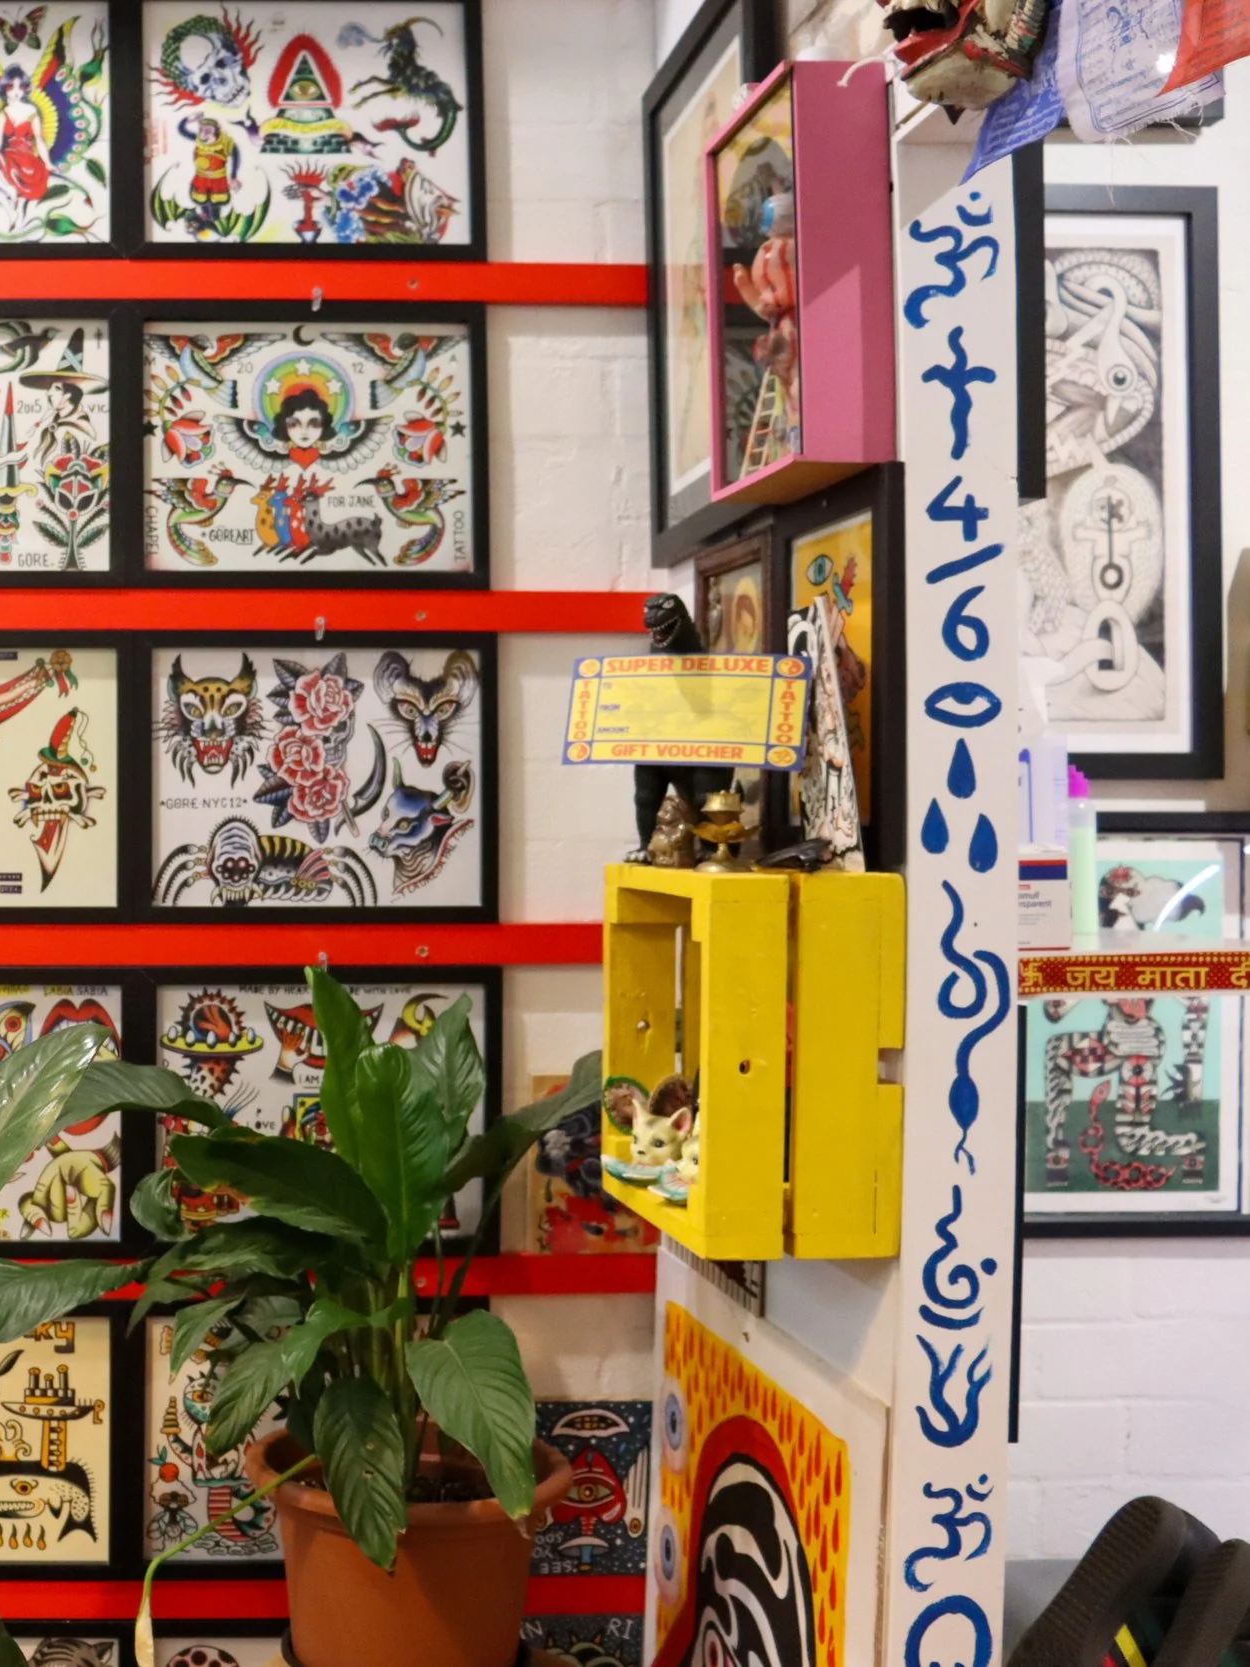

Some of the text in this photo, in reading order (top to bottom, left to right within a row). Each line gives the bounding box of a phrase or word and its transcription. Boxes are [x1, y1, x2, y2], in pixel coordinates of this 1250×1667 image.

[327, 495, 376, 508] FOR JANE
[145, 505, 160, 558] CHAPEL
[452, 510, 466, 562] TATTOO
[606, 657, 770, 674] SUPER DELUXE
[573, 680, 591, 741] TATTOO
[775, 679, 798, 744] TATTOO
[610, 743, 745, 760] GIFT VOUCHER
[1065, 965, 1121, 989] जय
[1134, 965, 1211, 988] माता
